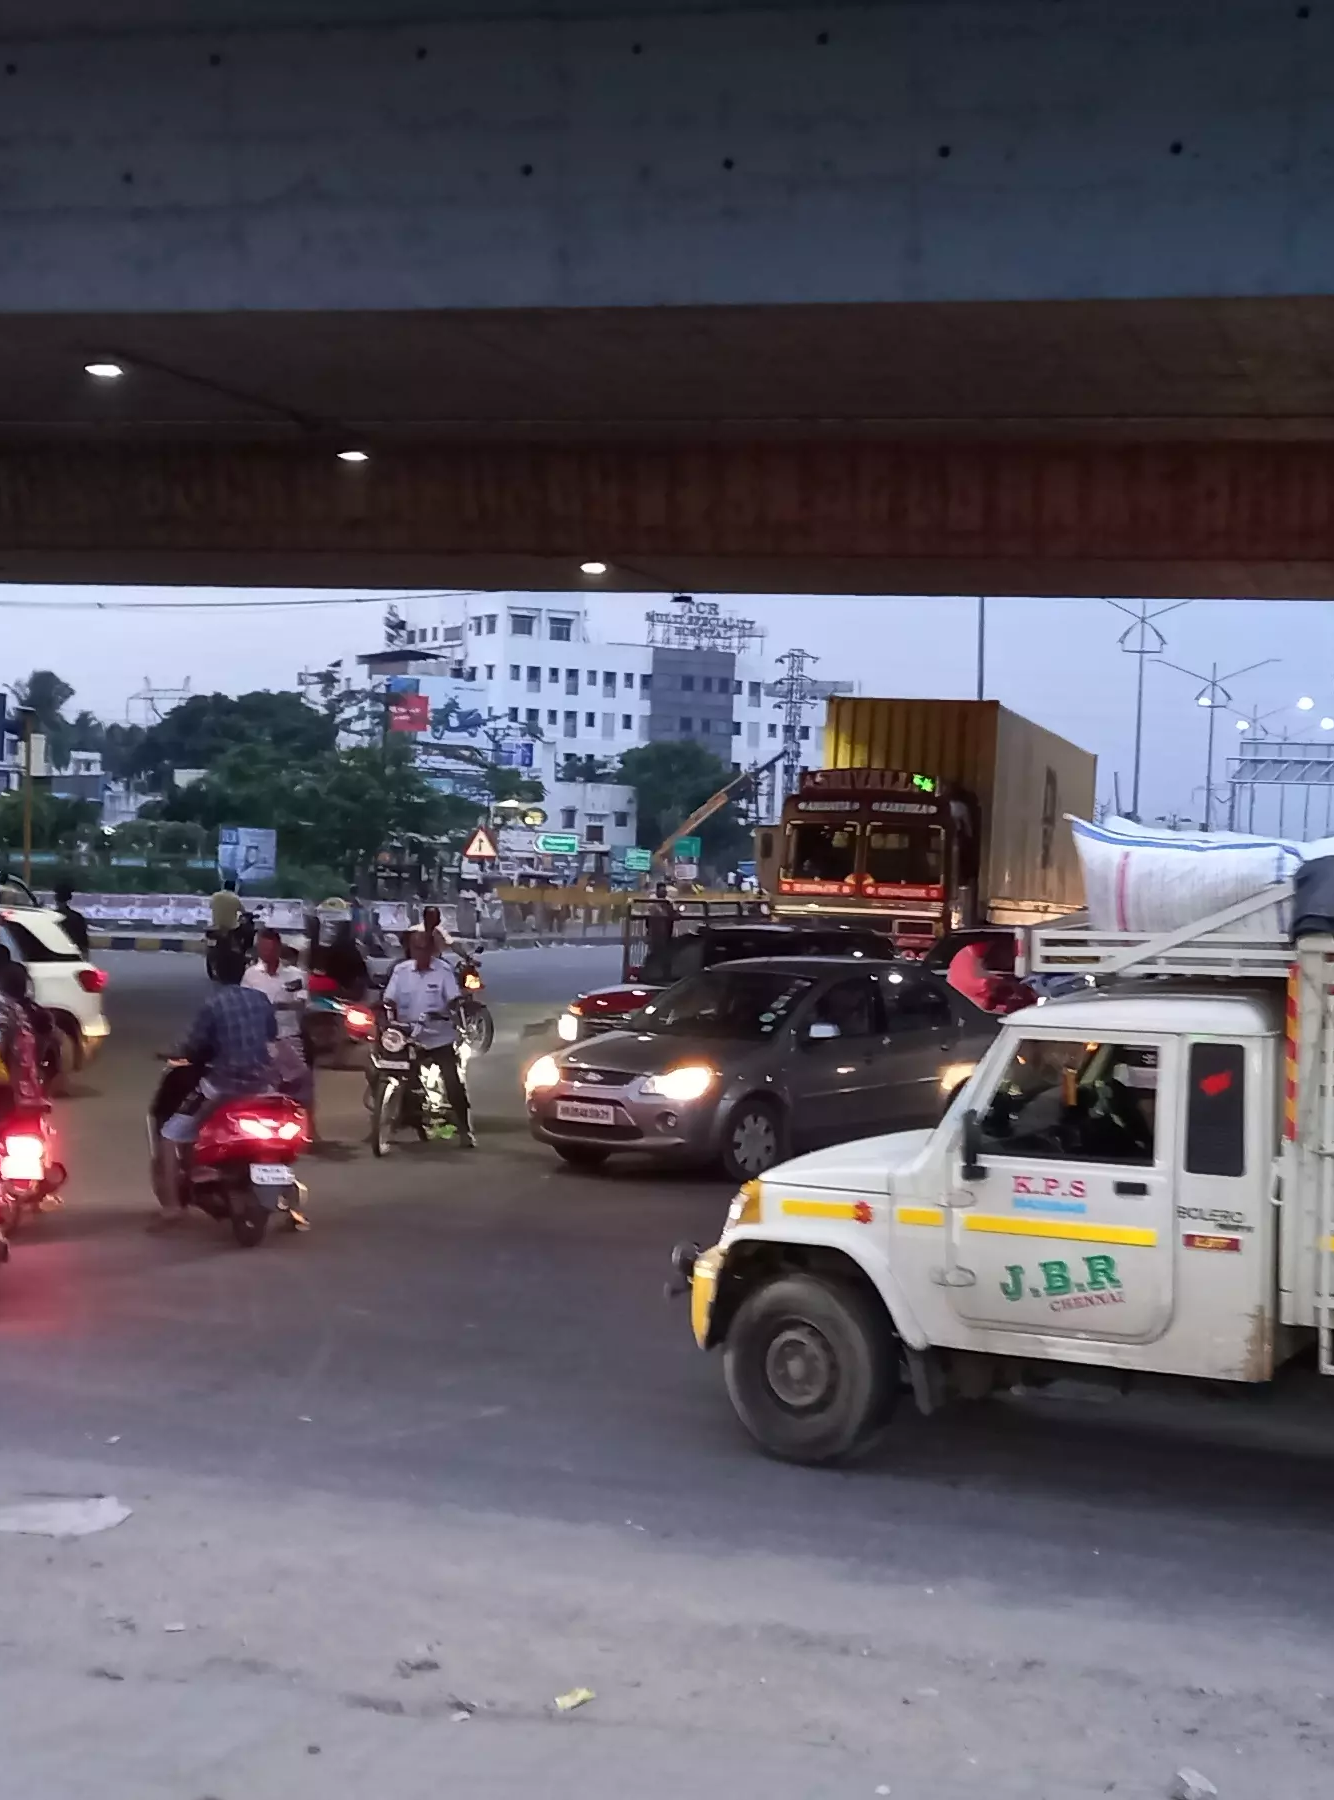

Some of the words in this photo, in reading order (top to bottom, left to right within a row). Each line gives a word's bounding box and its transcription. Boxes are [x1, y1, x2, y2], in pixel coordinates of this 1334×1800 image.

[1012, 1176, 1087, 1198] K.P.S
[999, 1255, 1123, 1302] J.B.R
[1049, 1290, 1126, 1313] CHENNAI
